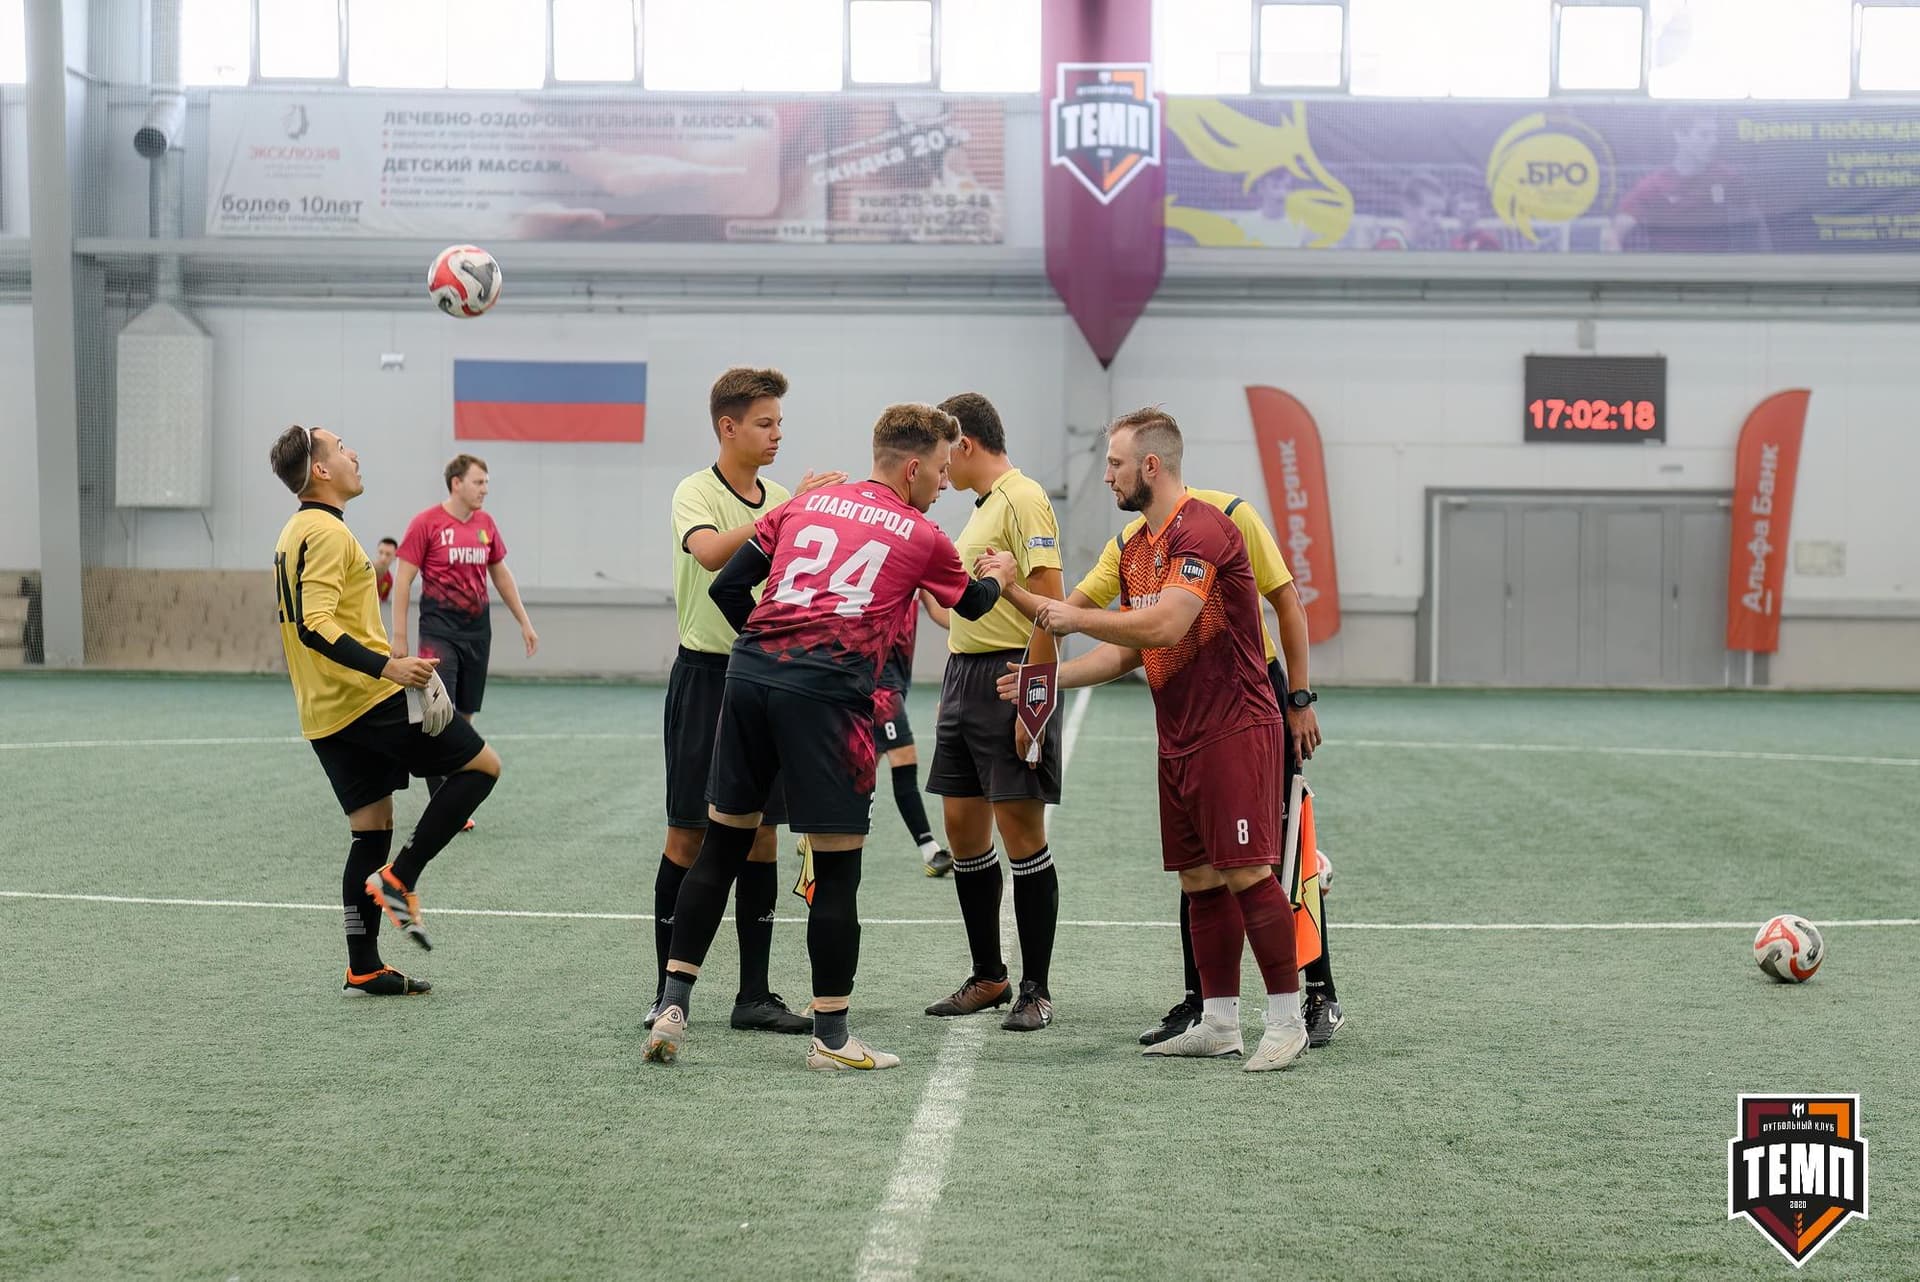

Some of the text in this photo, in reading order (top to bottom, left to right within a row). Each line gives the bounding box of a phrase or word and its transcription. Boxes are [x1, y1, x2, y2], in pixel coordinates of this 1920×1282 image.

[1061, 103, 1149, 149] ТЕМП
[249, 146, 340, 160] ЭКСКЛЮЗИВ
[383, 156, 472, 173] ДЕТСКИЙ
[812, 146, 905, 186] скидка
[910, 124, 971, 157] 20%
[222, 194, 363, 214] более 10лет
[1529, 399, 1656, 430] 17:02:18
[1278, 438, 1309, 510] Банк
[804, 494, 916, 541] СЛАВГОРОД
[1741, 443, 1779, 613] Альфа Банк
[441, 528, 454, 546] 17
[449, 546, 487, 565] РУБИН
[772, 524, 892, 618] 24
[1183, 565, 1204, 577] ТЕМП
[884, 721, 897, 740] 8
[1237, 818, 1249, 845] 8
